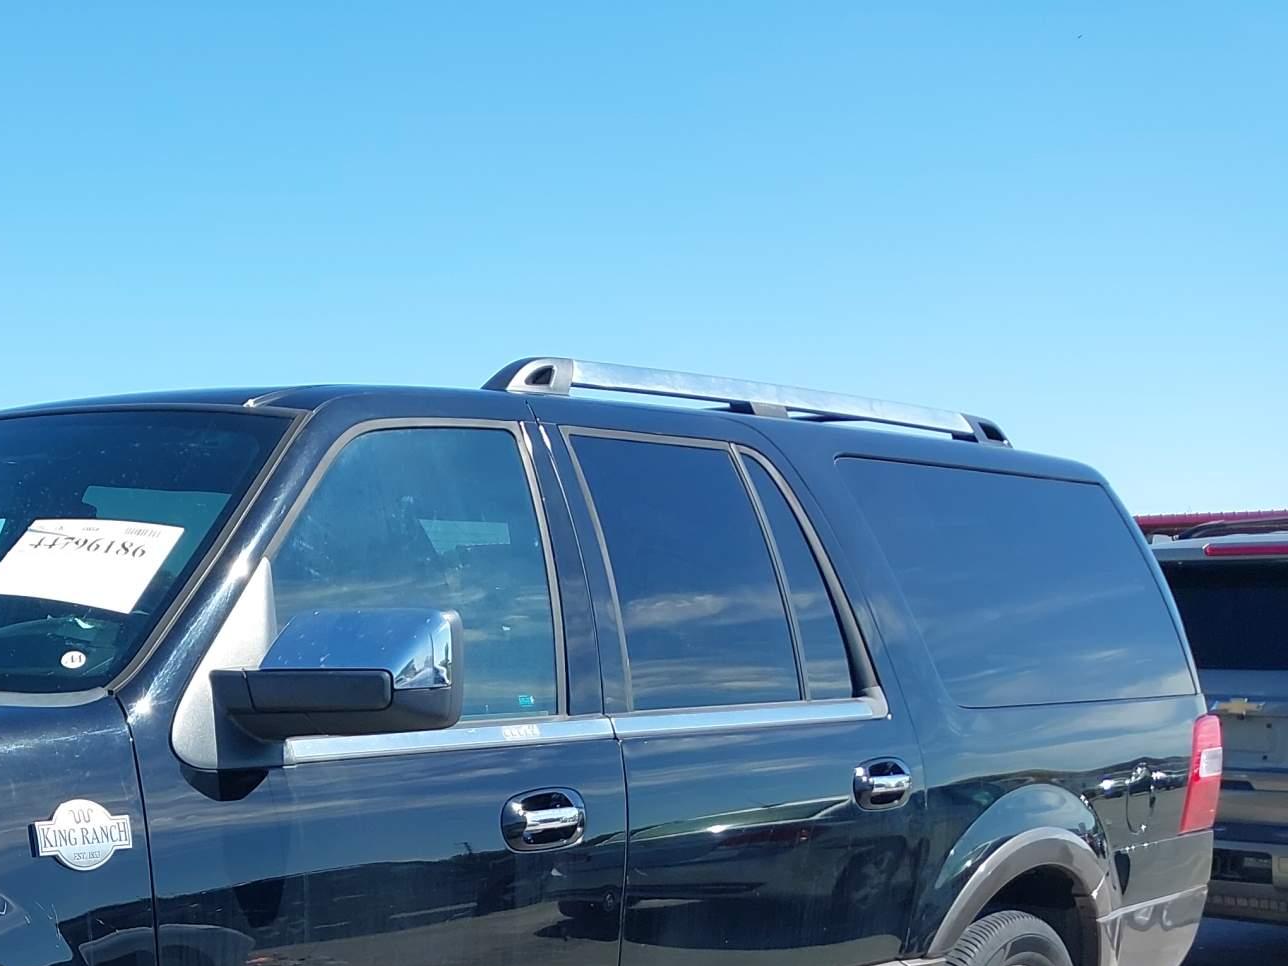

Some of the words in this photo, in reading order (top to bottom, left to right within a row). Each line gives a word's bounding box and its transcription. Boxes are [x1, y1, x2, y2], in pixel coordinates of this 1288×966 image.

[30, 536, 146, 557] 44796186
[41, 827, 78, 849] KING
[80, 821, 128, 845] RANCH
